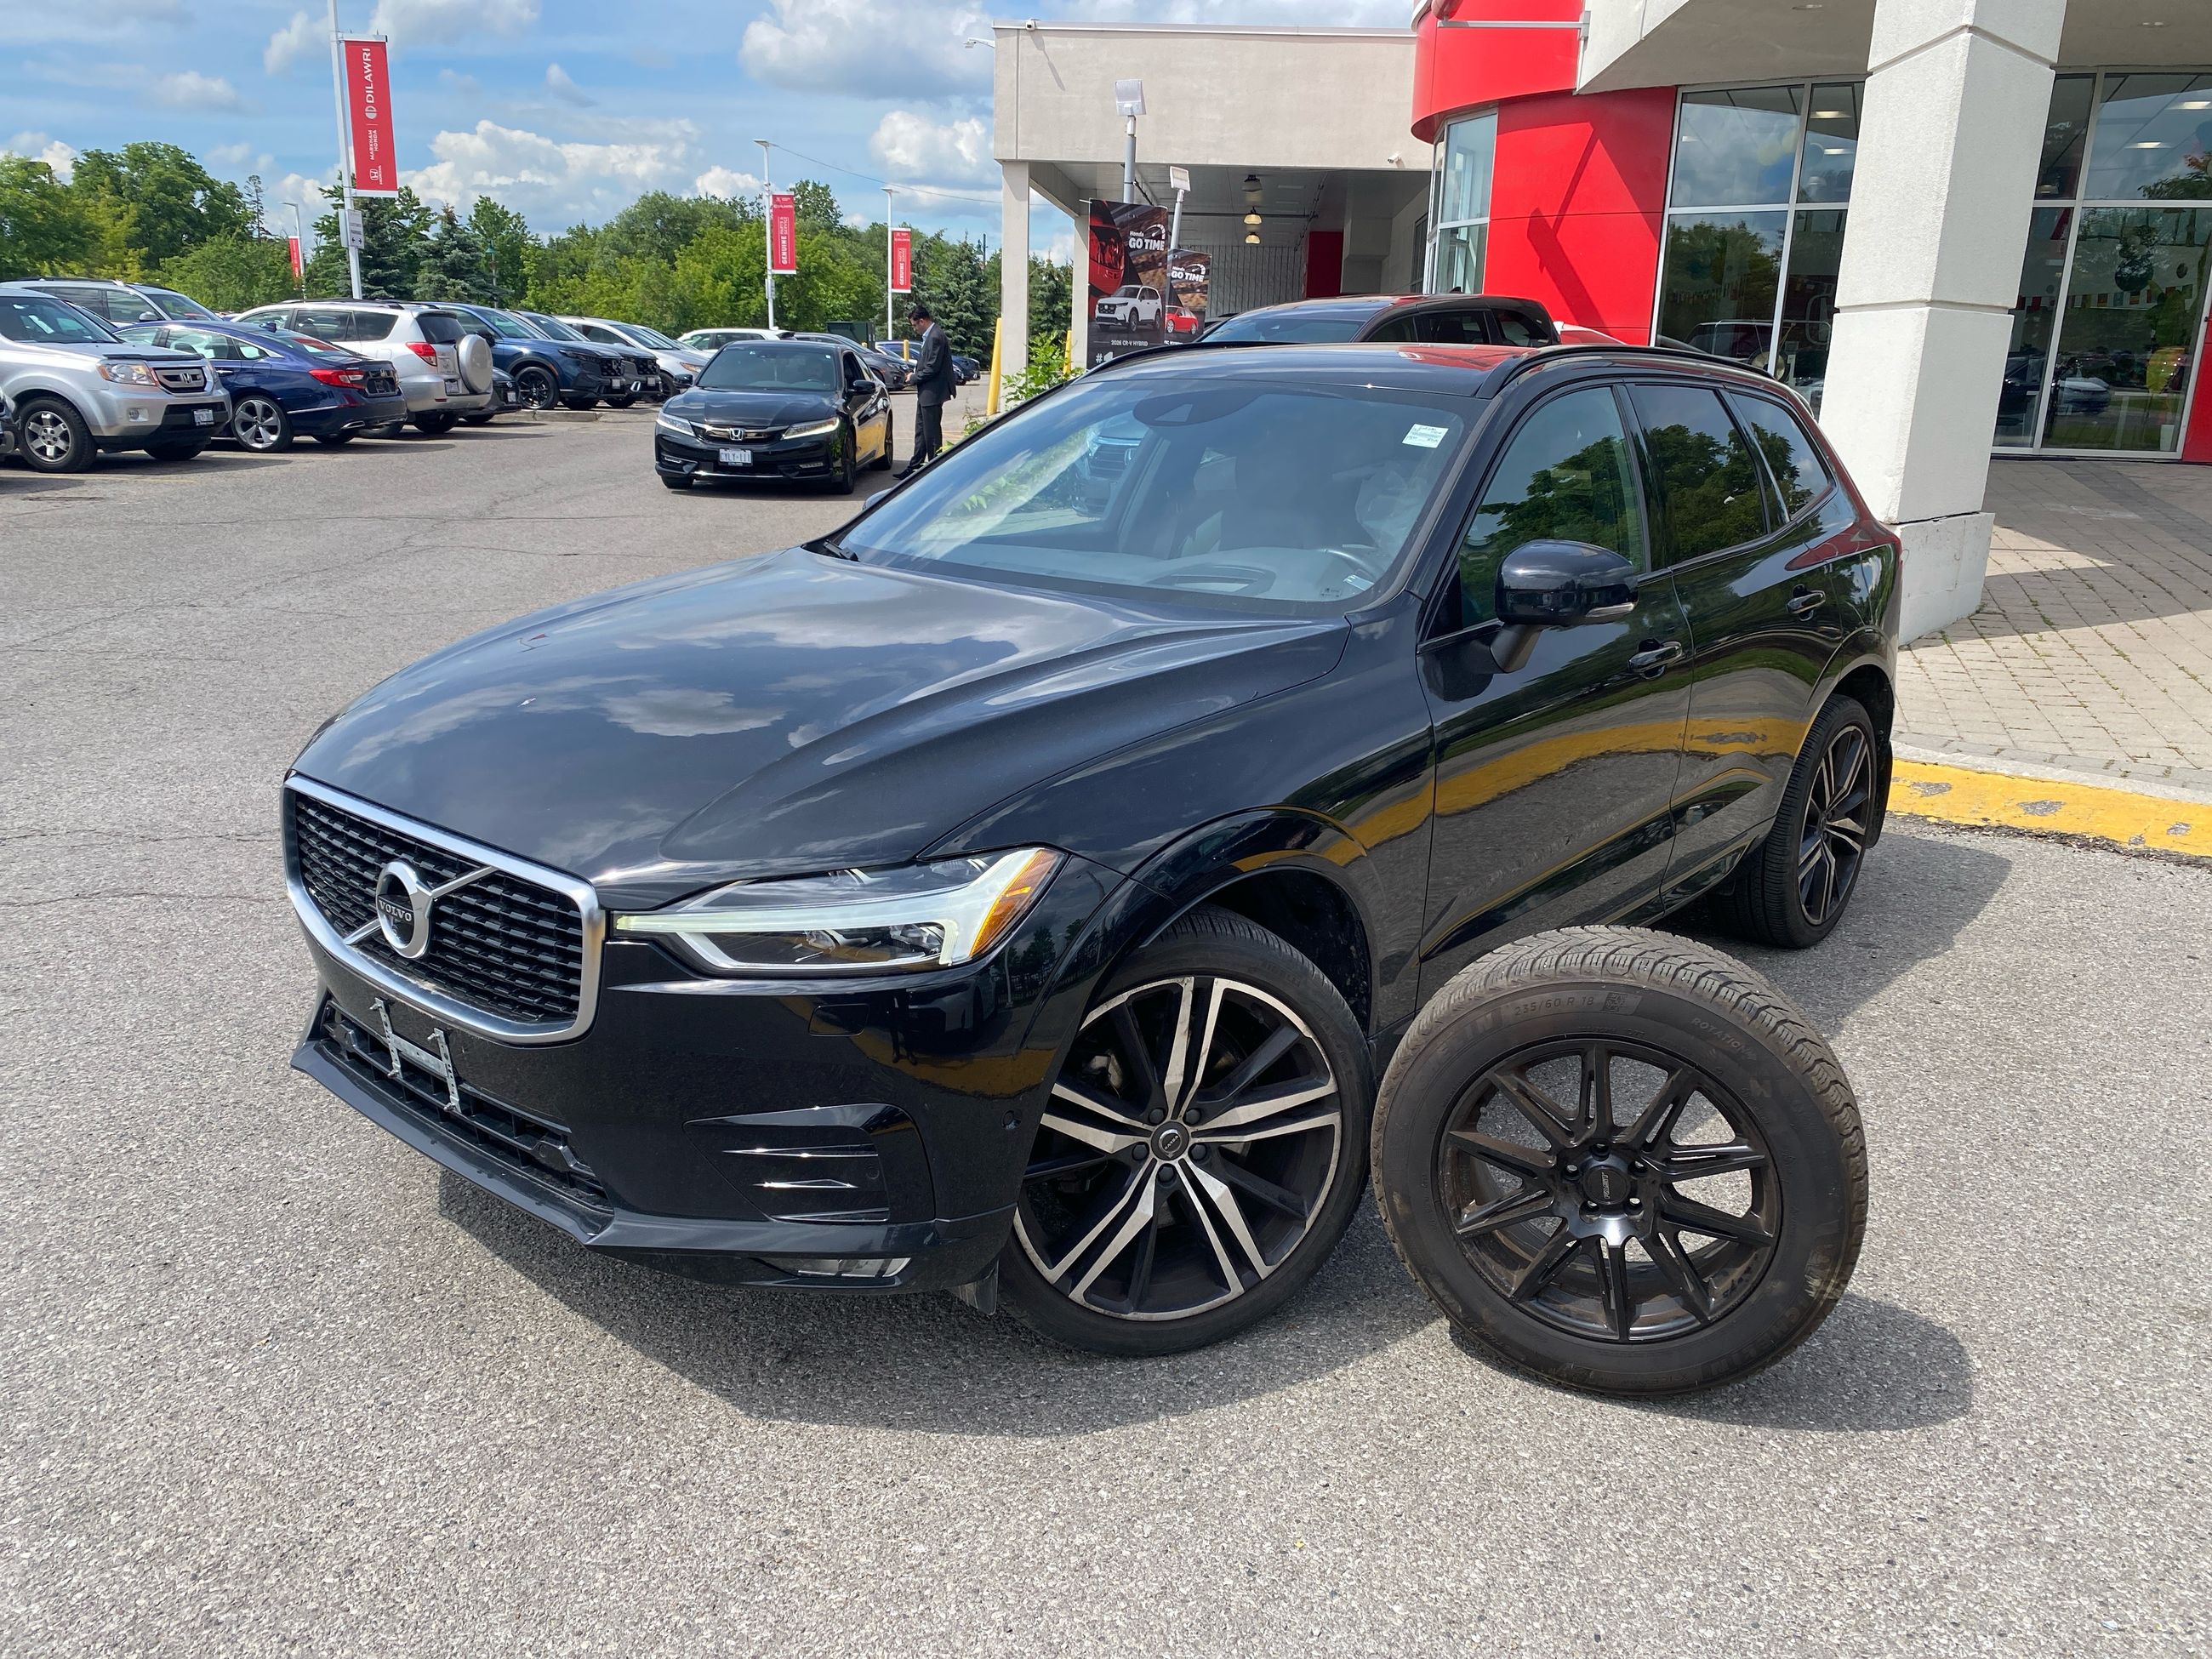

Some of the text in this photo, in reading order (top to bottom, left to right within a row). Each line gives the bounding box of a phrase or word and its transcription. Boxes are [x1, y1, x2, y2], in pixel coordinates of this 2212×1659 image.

[362, 48, 375, 104] DILAWRI
[1128, 237, 1166, 251] GO TIME
[1171, 271, 1205, 282] GO TIME
[378, 899, 413, 922] VOLVO
[1514, 996, 1595, 1017] 235/60 R 18
[1164, 1135, 1179, 1150] VOLVO
